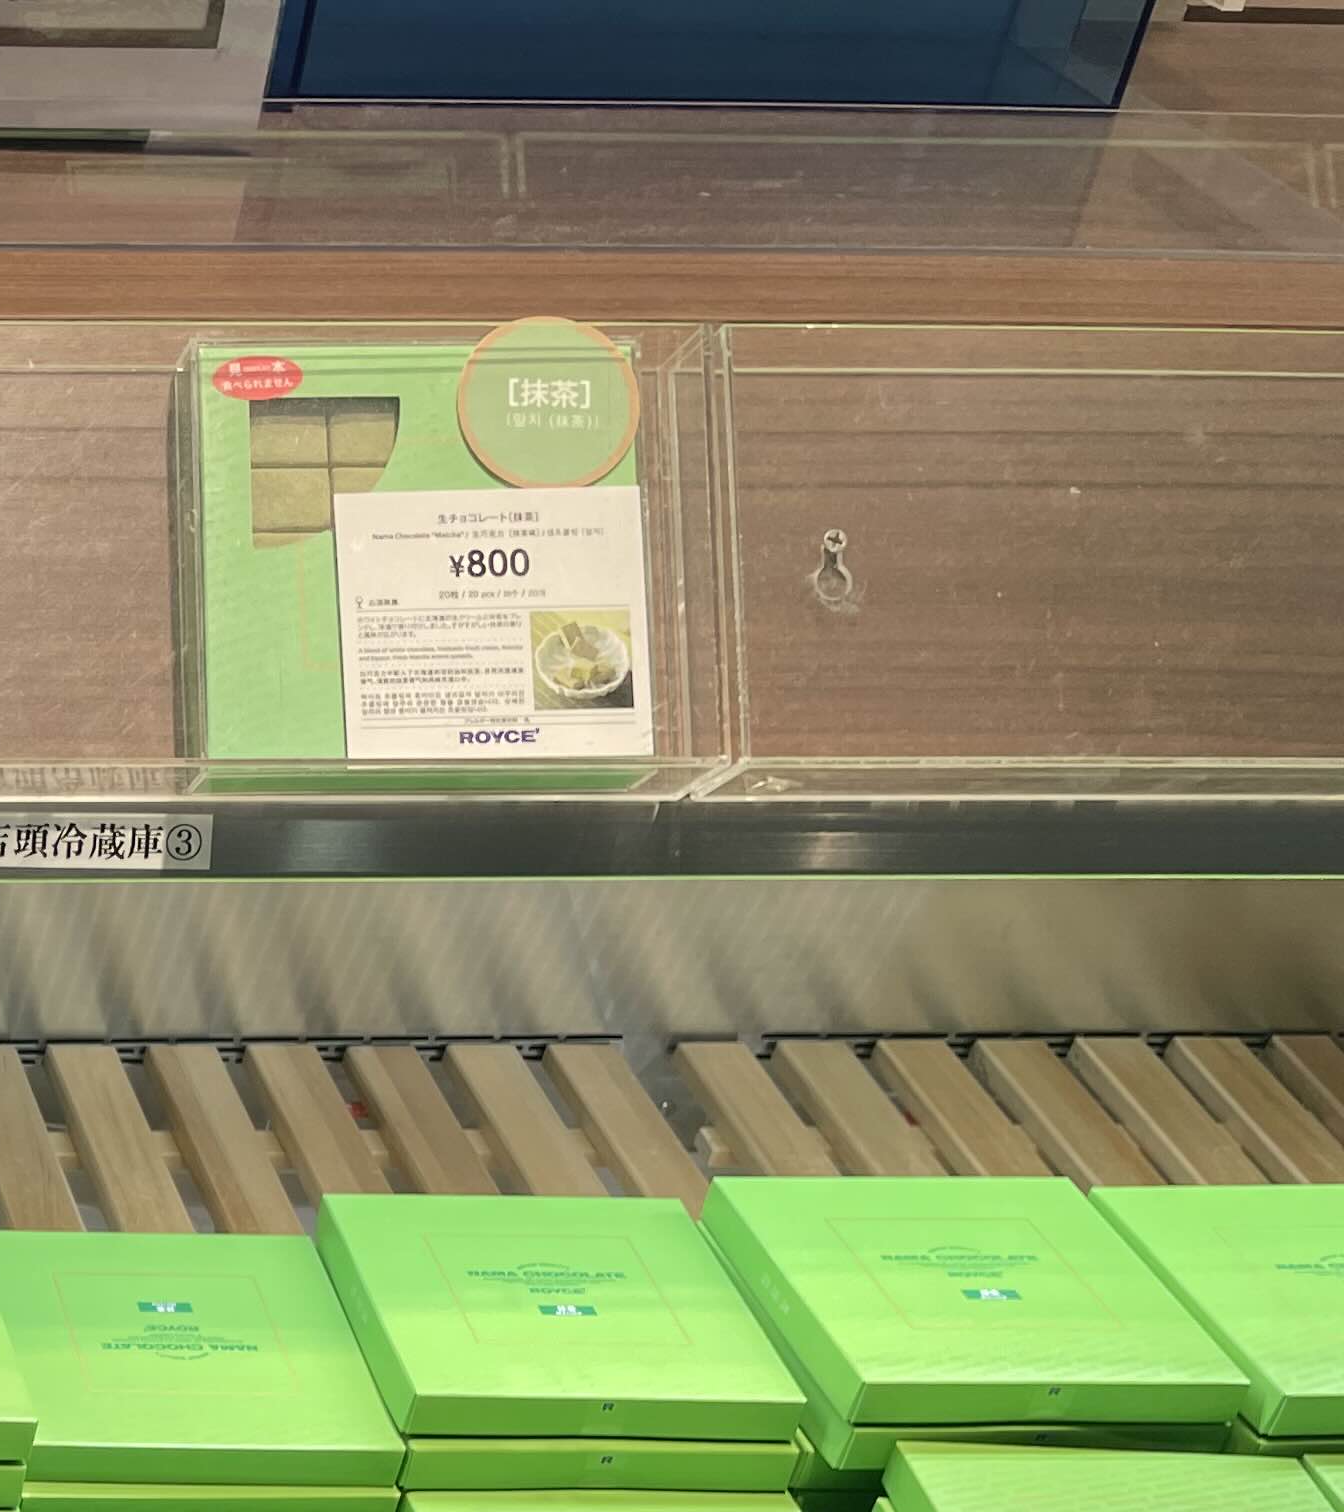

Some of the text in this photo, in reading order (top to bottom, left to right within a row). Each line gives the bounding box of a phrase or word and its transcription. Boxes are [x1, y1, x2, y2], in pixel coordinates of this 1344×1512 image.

[509, 378, 591, 408] [抹茶]
[449, 549, 530, 578] ¥800
[459, 728, 540, 744] ROYCE'
